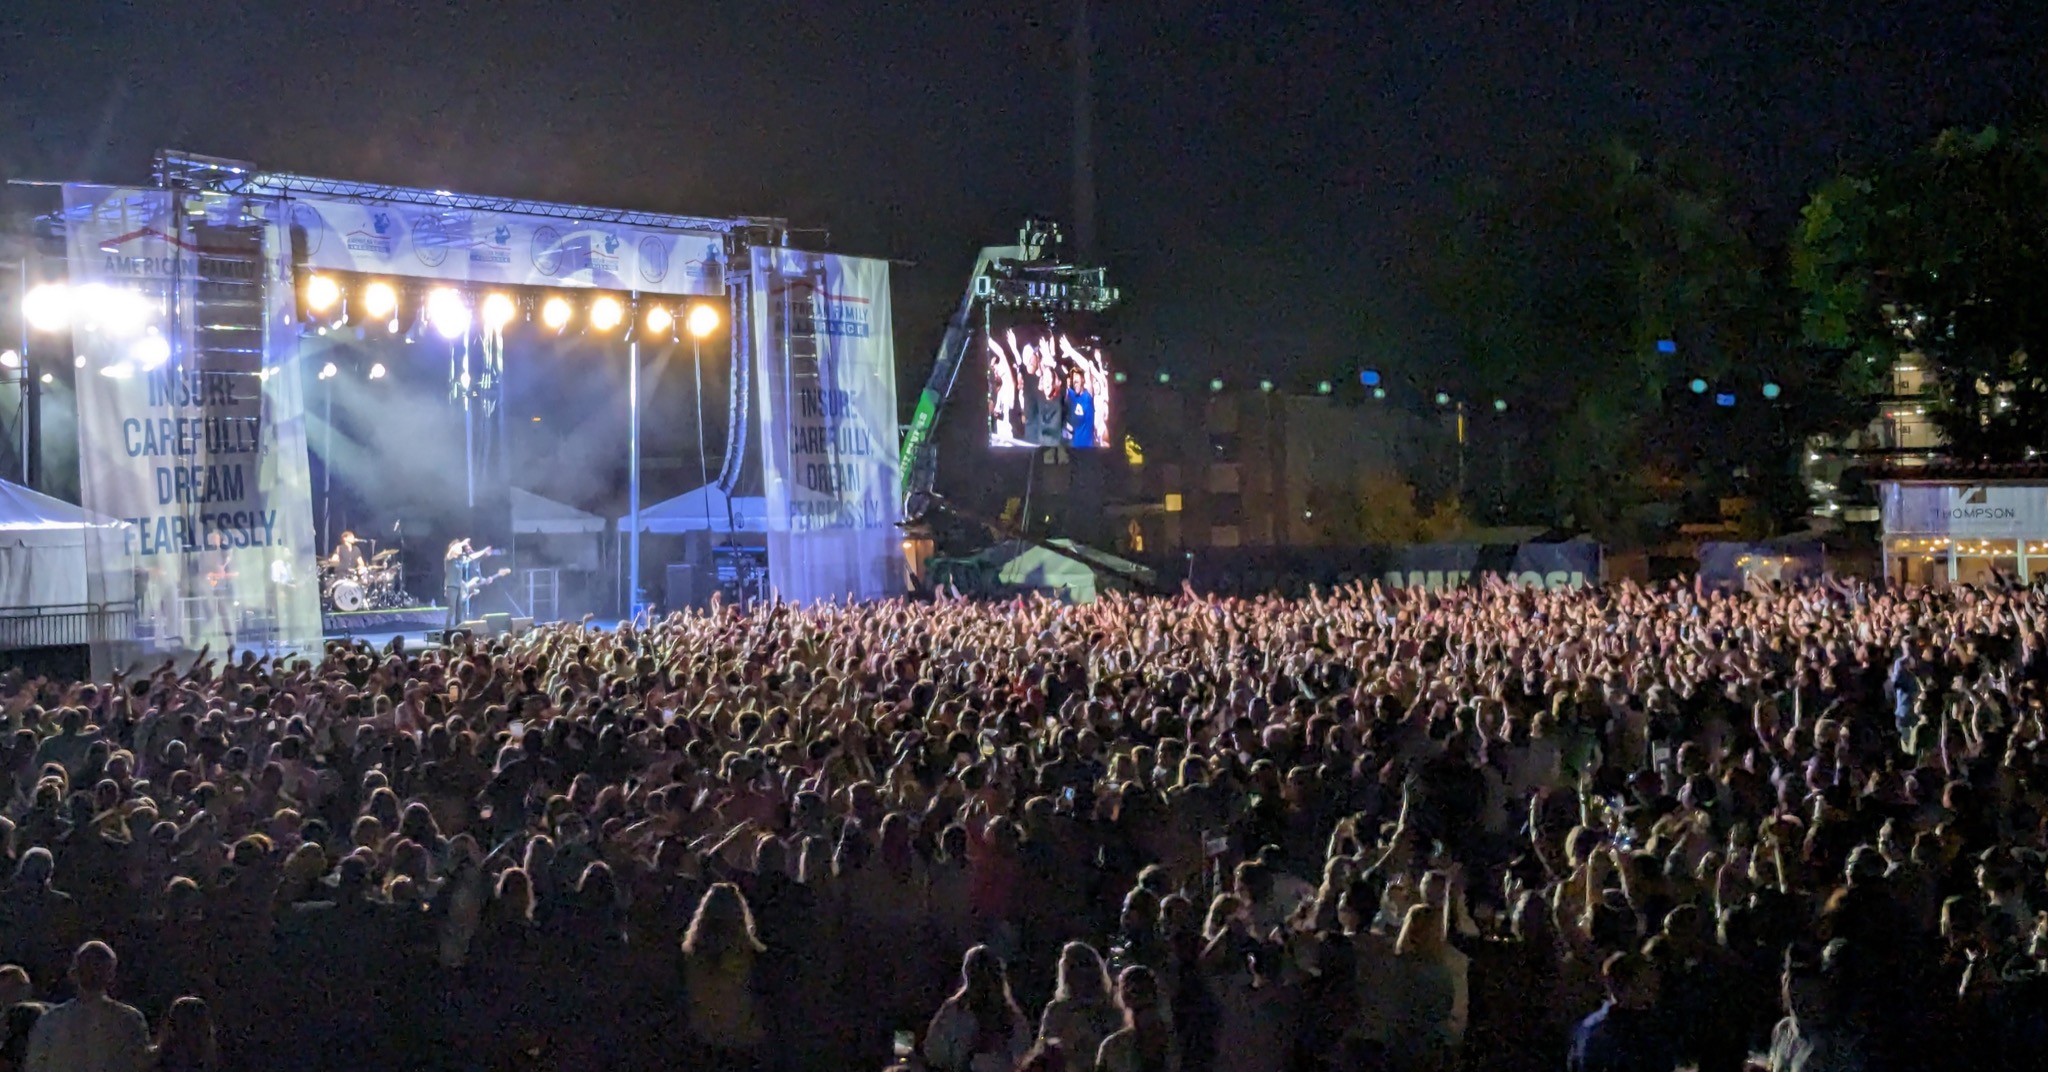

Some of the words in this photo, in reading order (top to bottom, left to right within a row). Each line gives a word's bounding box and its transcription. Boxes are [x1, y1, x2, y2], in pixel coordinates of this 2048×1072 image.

[148, 370, 239, 407] INSURE
[801, 388, 858, 419] INSURE
[157, 464, 244, 505] DREAM
[806, 463, 860, 493] DREAM
[1934, 508, 2015, 519] THOMPSON
[123, 510, 282, 556] FEARLESSLY.
